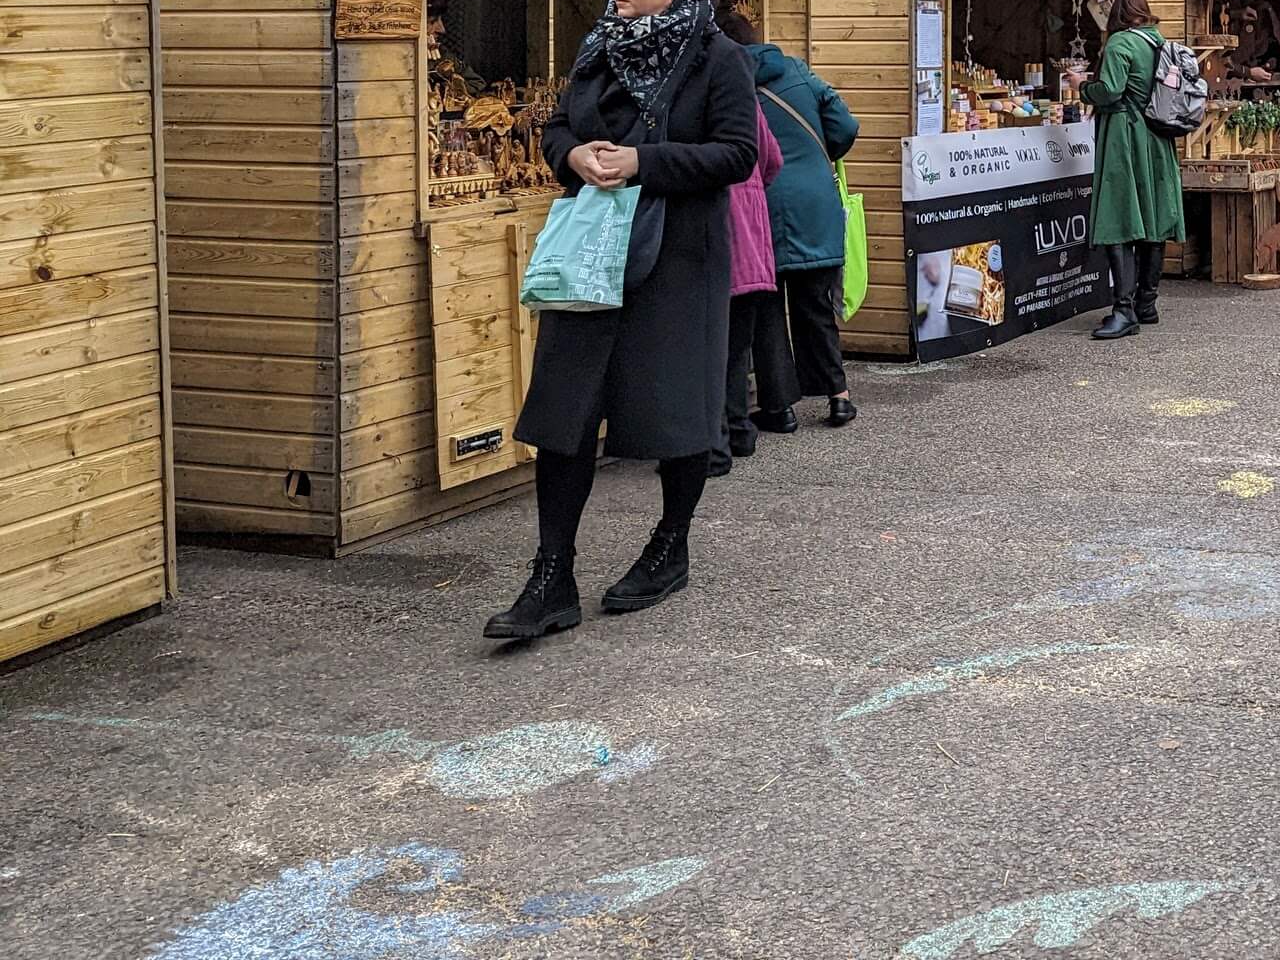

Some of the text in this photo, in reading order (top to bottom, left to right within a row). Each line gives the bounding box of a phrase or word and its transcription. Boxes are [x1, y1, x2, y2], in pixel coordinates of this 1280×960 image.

[949, 145, 1009, 162] 100% NATURAL
[1014, 147, 1041, 164] VOGUE
[918, 167, 941, 185] Vegan
[949, 160, 1011, 177] & ORGANIC
[916, 210, 939, 225] 100%
[939, 205, 966, 221] Natural
[966, 206, 973, 217] &
[974, 201, 1004, 218] Organic
[1008, 194, 1039, 209] Handmade
[1077, 185, 1092, 198] Vegan
[1014, 287, 1048, 306] CRUELTY-FREE
[1051, 285, 1062, 294] NOT
[1018, 306, 1026, 316] NO
[1026, 299, 1051, 313] PARABENS
